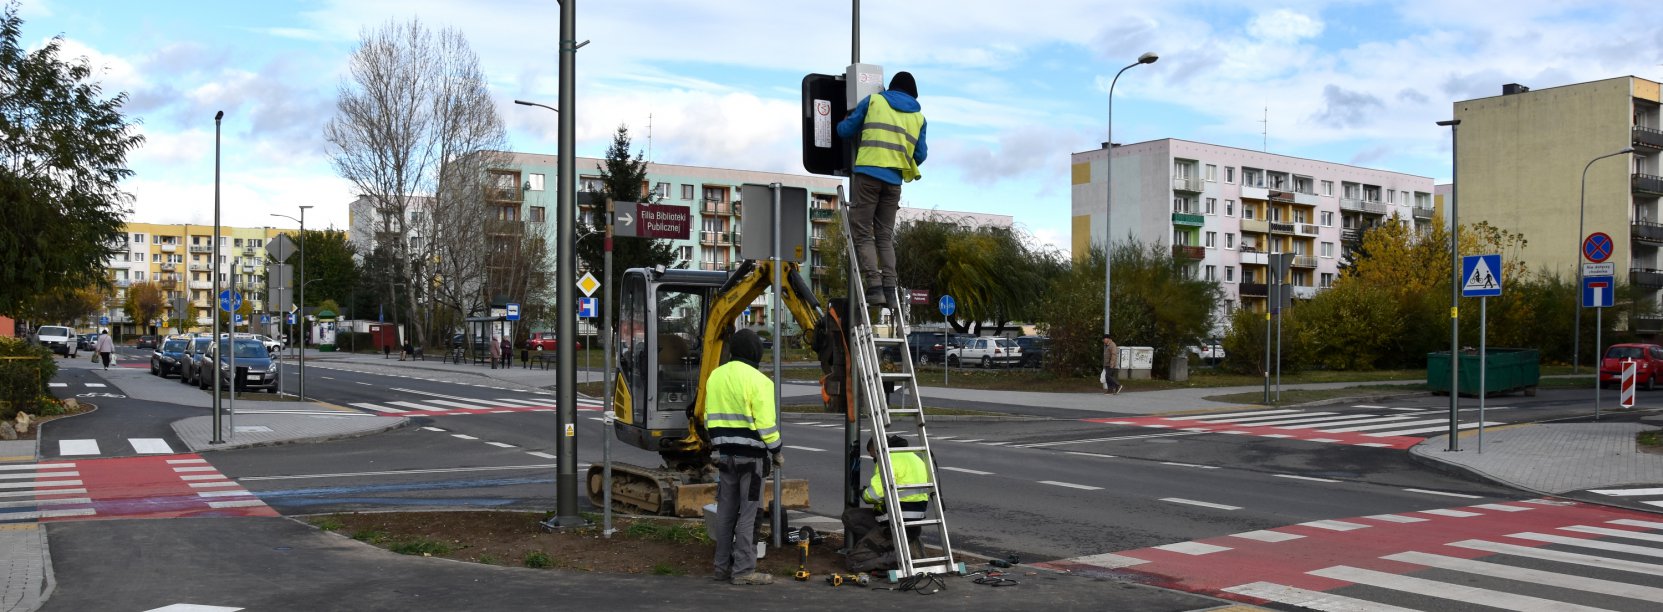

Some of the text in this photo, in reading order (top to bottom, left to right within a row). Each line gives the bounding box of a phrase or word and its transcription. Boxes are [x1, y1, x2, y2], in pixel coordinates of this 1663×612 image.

[642, 211, 686, 221] Filia Biblioteki
[647, 222, 681, 233] Publicznej
